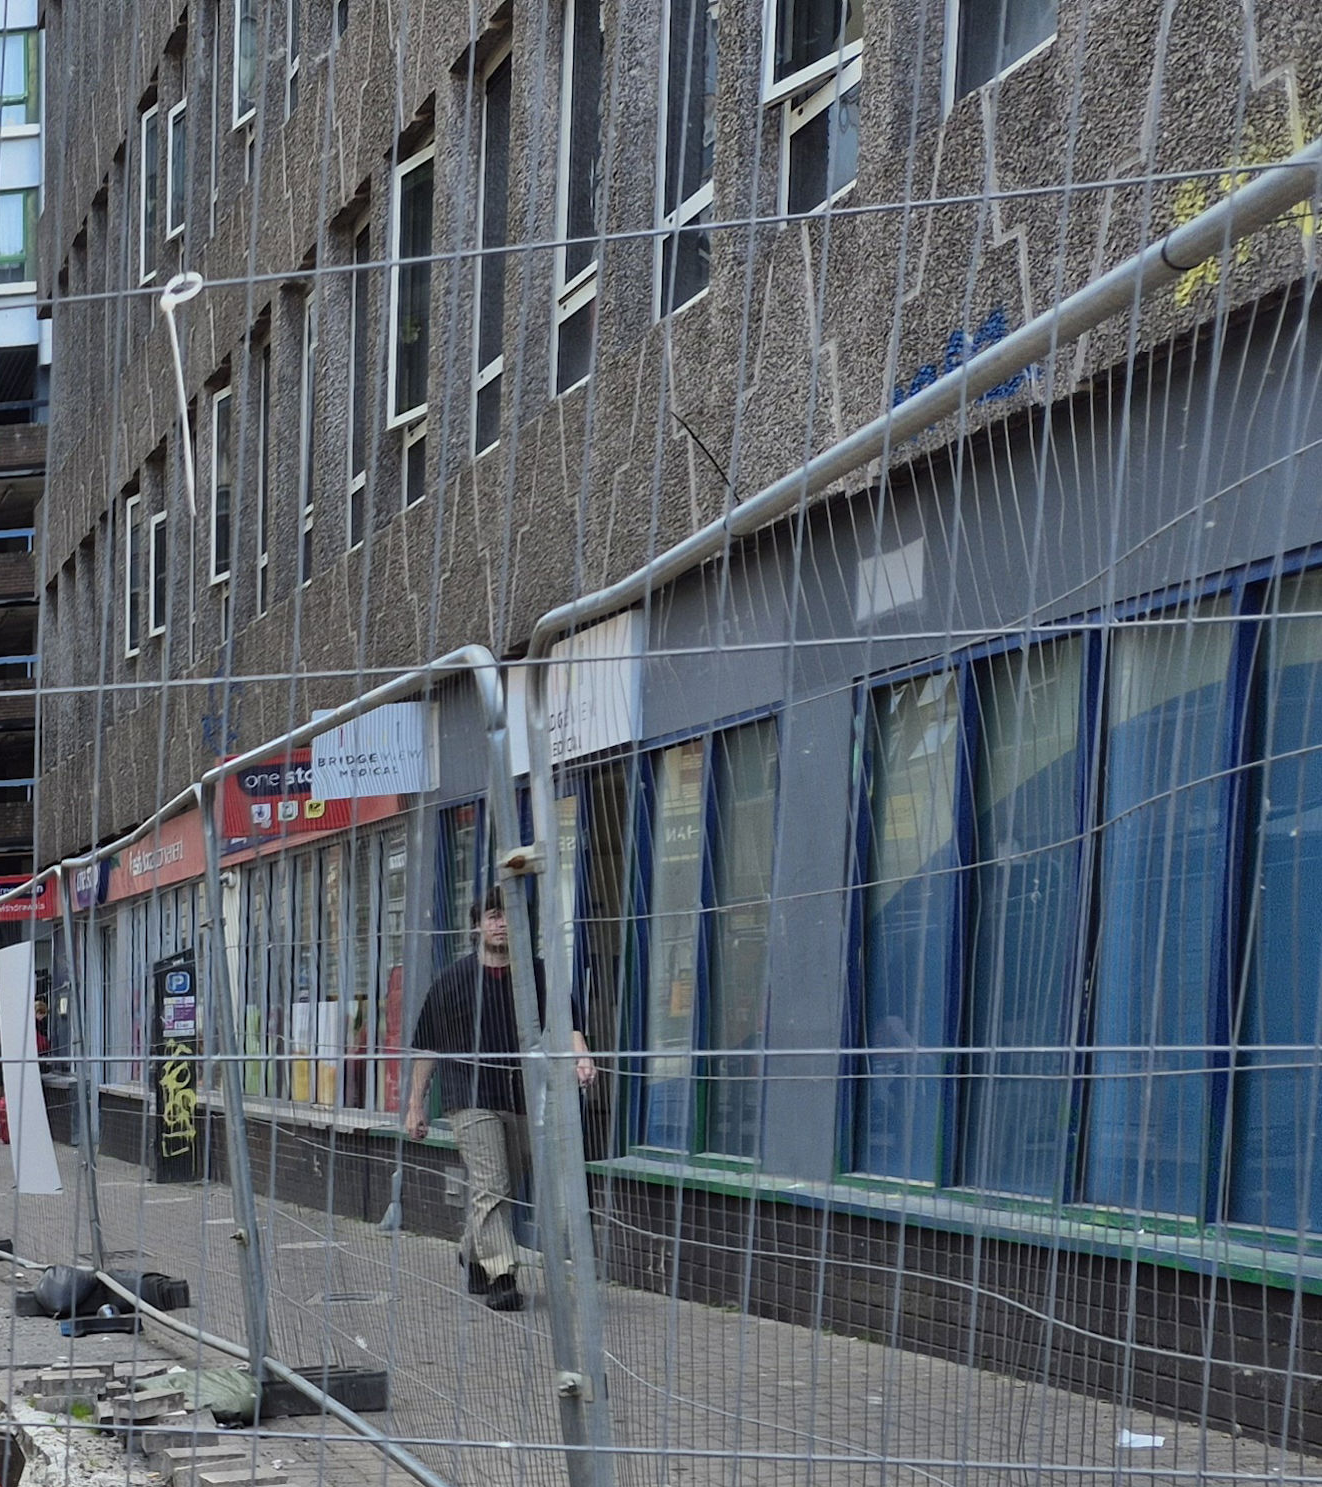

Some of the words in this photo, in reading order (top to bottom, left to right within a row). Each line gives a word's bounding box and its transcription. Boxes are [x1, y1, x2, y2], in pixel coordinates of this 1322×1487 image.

[244, 771, 280, 788] one
[284, 766, 312, 783] sto
[339, 766, 399, 778] MEDICAL
